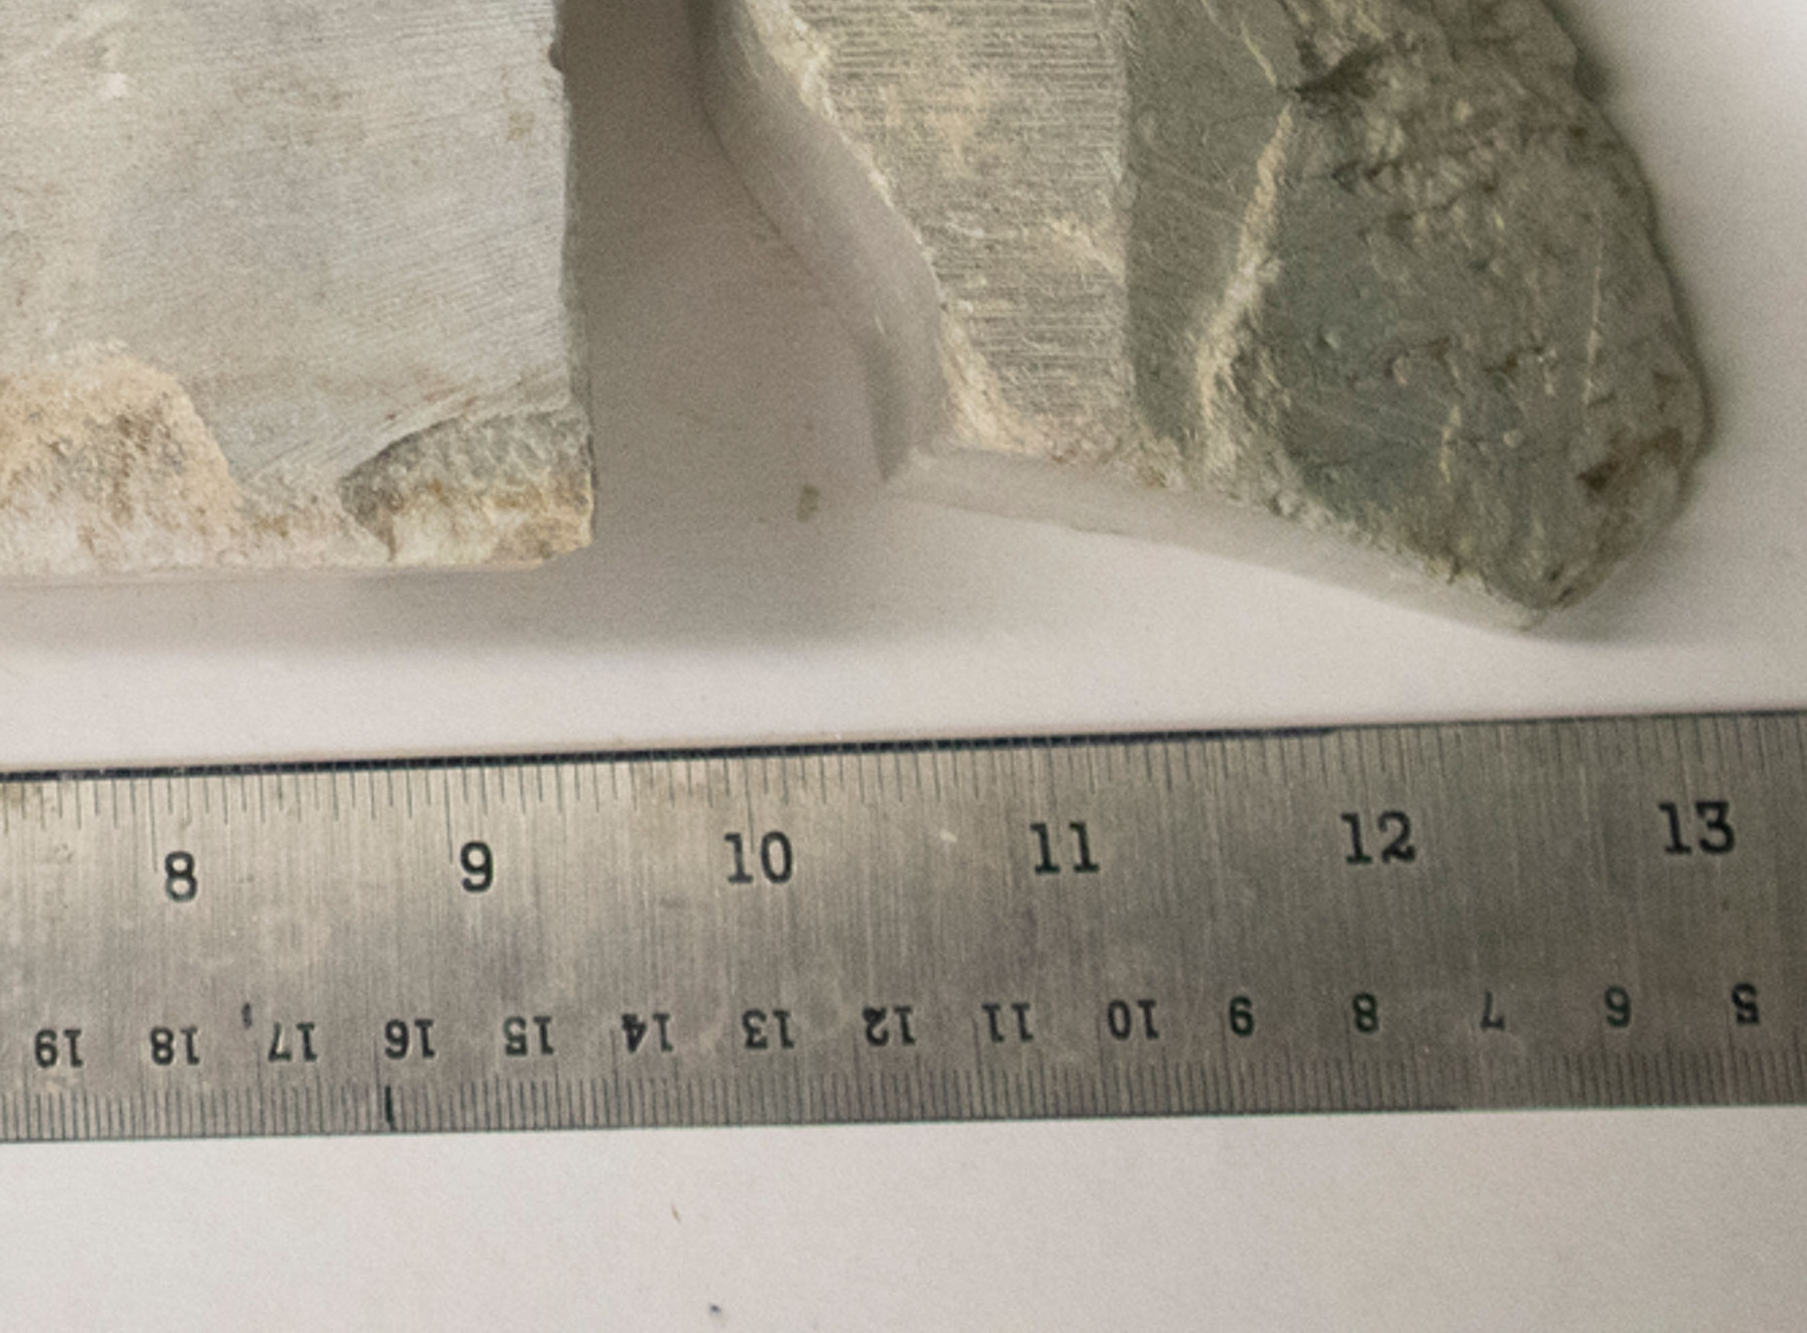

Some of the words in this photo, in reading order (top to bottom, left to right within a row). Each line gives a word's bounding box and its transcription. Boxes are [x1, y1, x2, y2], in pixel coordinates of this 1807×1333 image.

[164, 850, 198, 902] 8
[460, 840, 494, 893] 9
[724, 830, 794, 885] 10
[1030, 821, 1099, 875] 11
[1340, 810, 1416, 865] 12
[1658, 799, 1736, 856] 13
[981, 1002, 1034, 1044] 11
[1107, 999, 1159, 1041] 10
[1228, 996, 1255, 1037] 9
[1352, 992, 1379, 1033] 8
[1480, 990, 1505, 1031] 7
[1604, 986, 1632, 1028] 6
[1731, 982, 1760, 1026] 5
[150, 1025, 200, 1067] 18
[267, 1022, 318, 1064] 17
[384, 1018, 436, 1062] 16
[503, 1015, 554, 1057] 15
[621, 1011, 674, 1054] 14
[742, 1008, 795, 1050] 13
[862, 1005, 916, 1047] 12
[34, 1028, 84, 1069] 19
